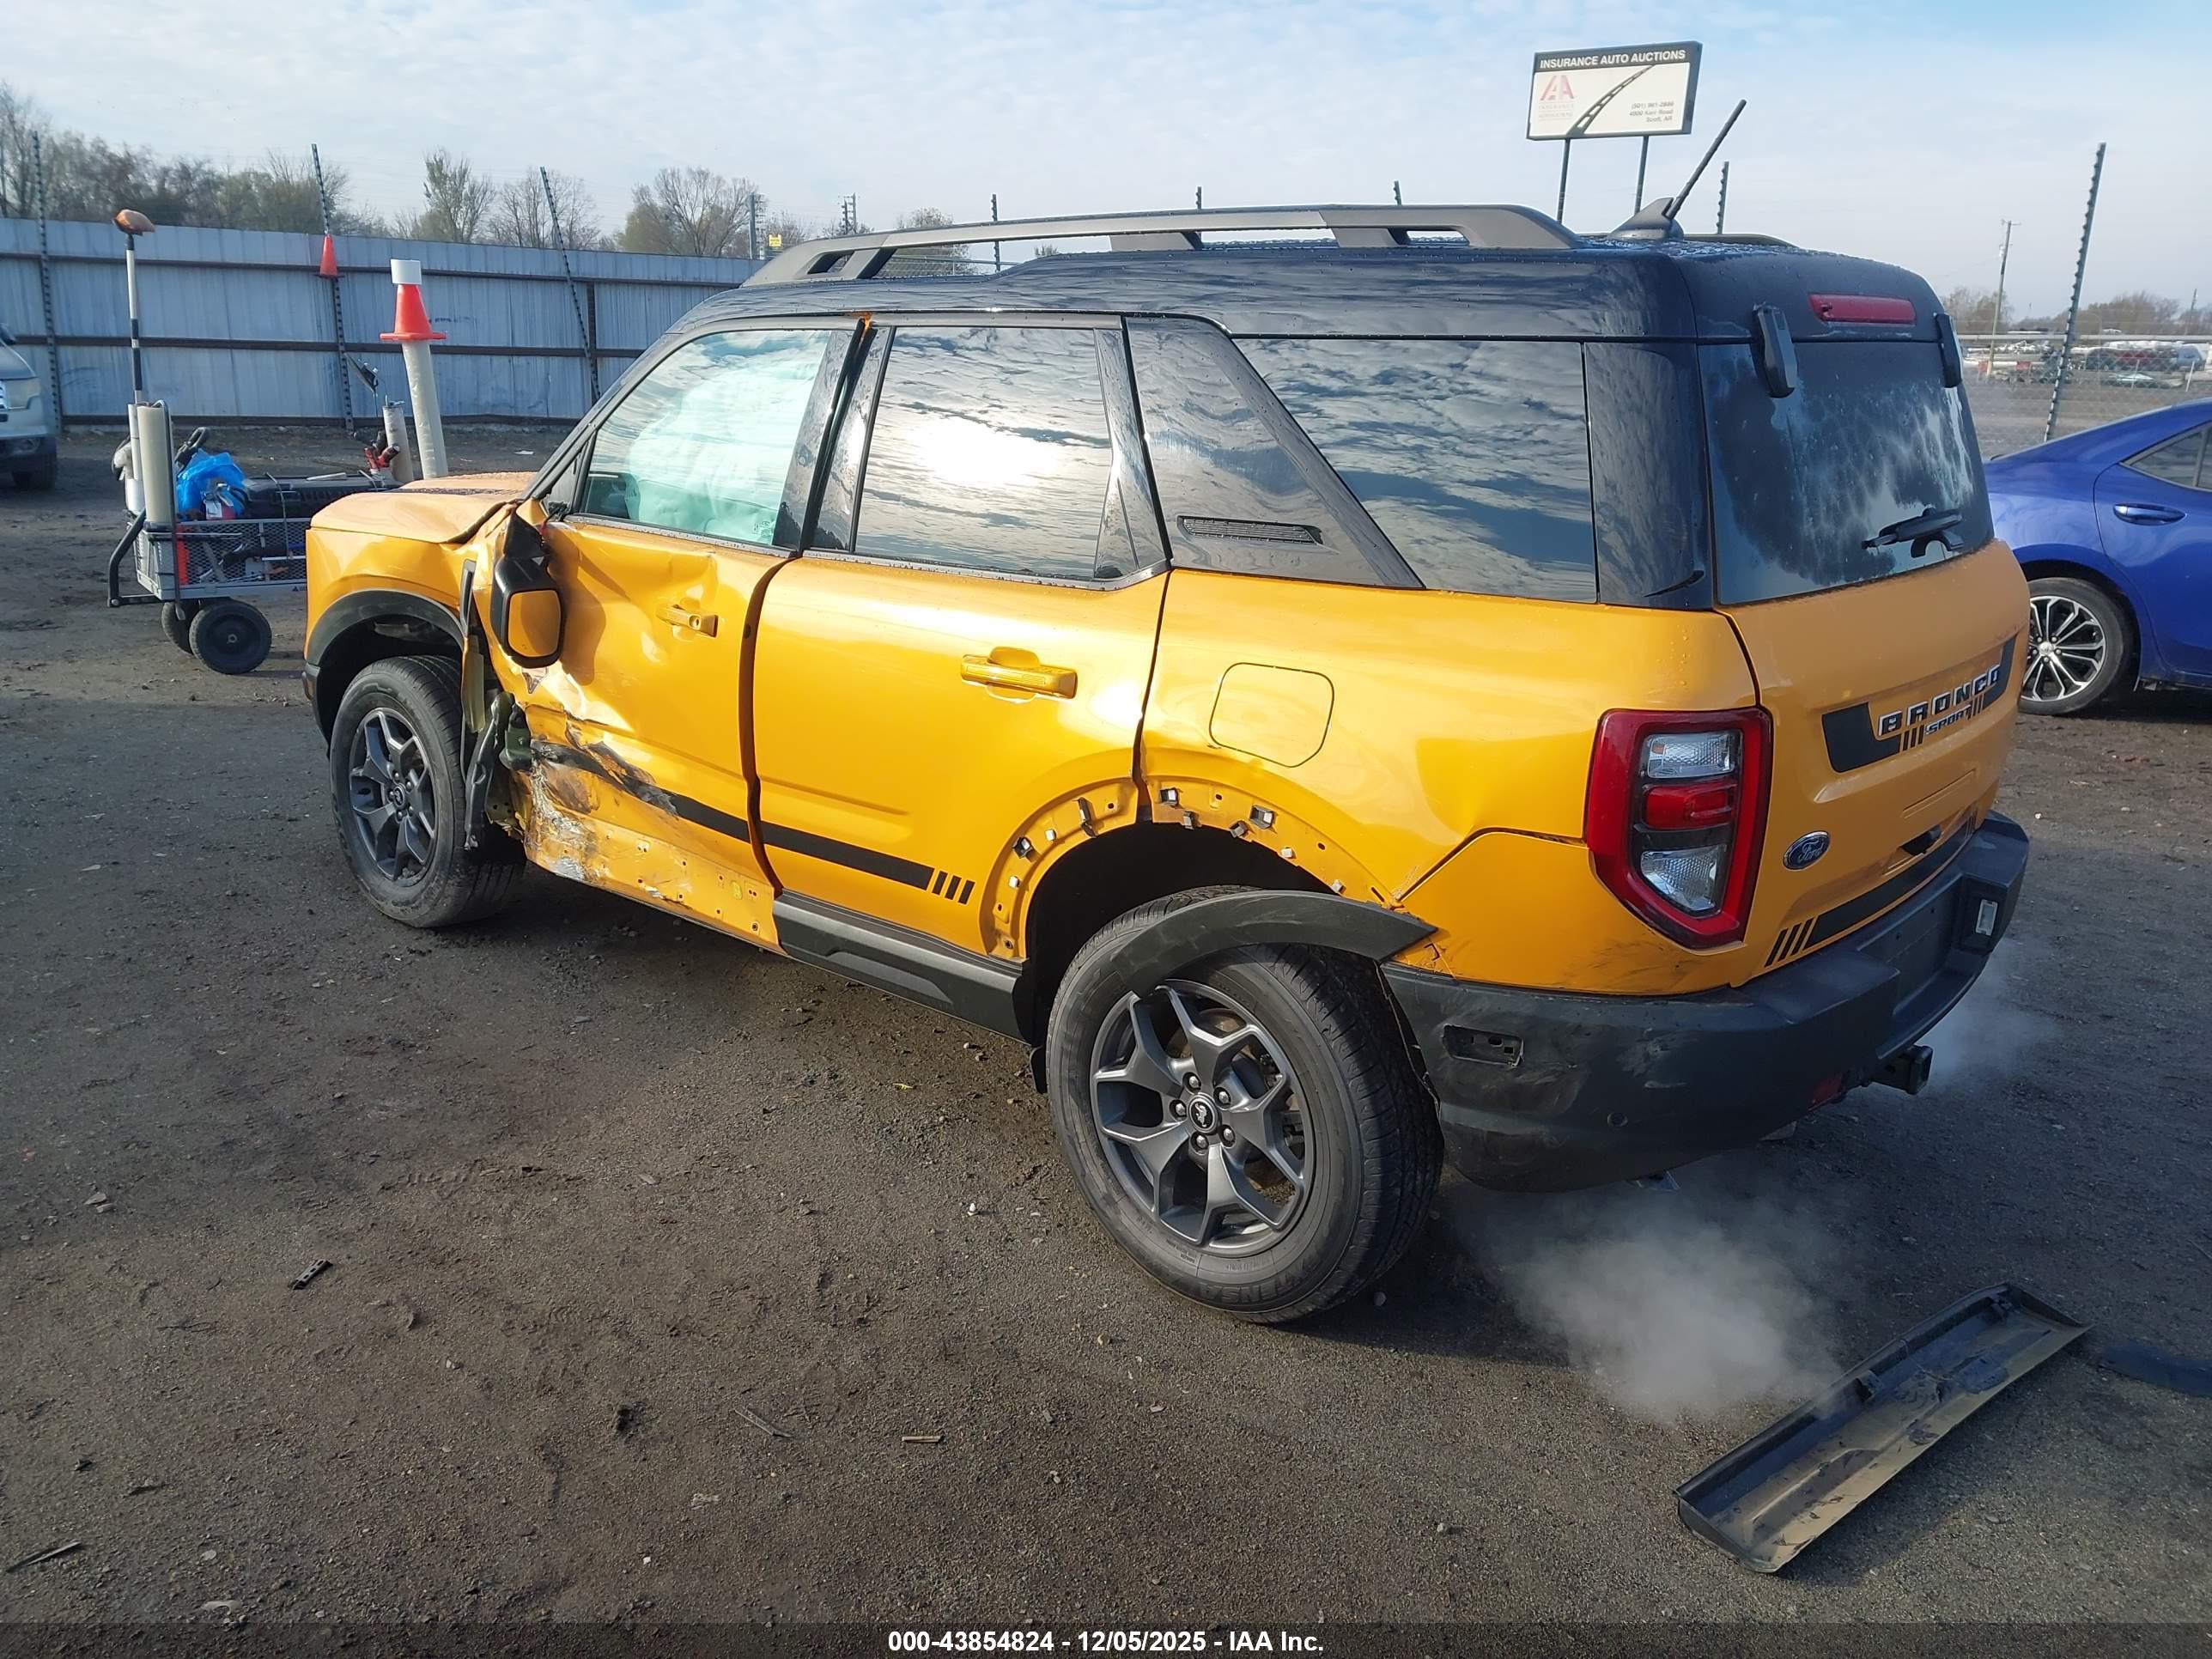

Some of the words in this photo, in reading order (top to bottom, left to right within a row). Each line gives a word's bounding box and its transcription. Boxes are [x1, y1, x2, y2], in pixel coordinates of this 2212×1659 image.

[1540, 56, 1598, 69] INSURANCE
[1600, 53, 1629, 65] AUTO
[1631, 49, 1686, 63] AUCTIONS
[1879, 665, 2001, 736] BRONCO
[1924, 704, 1973, 734] SPORT
